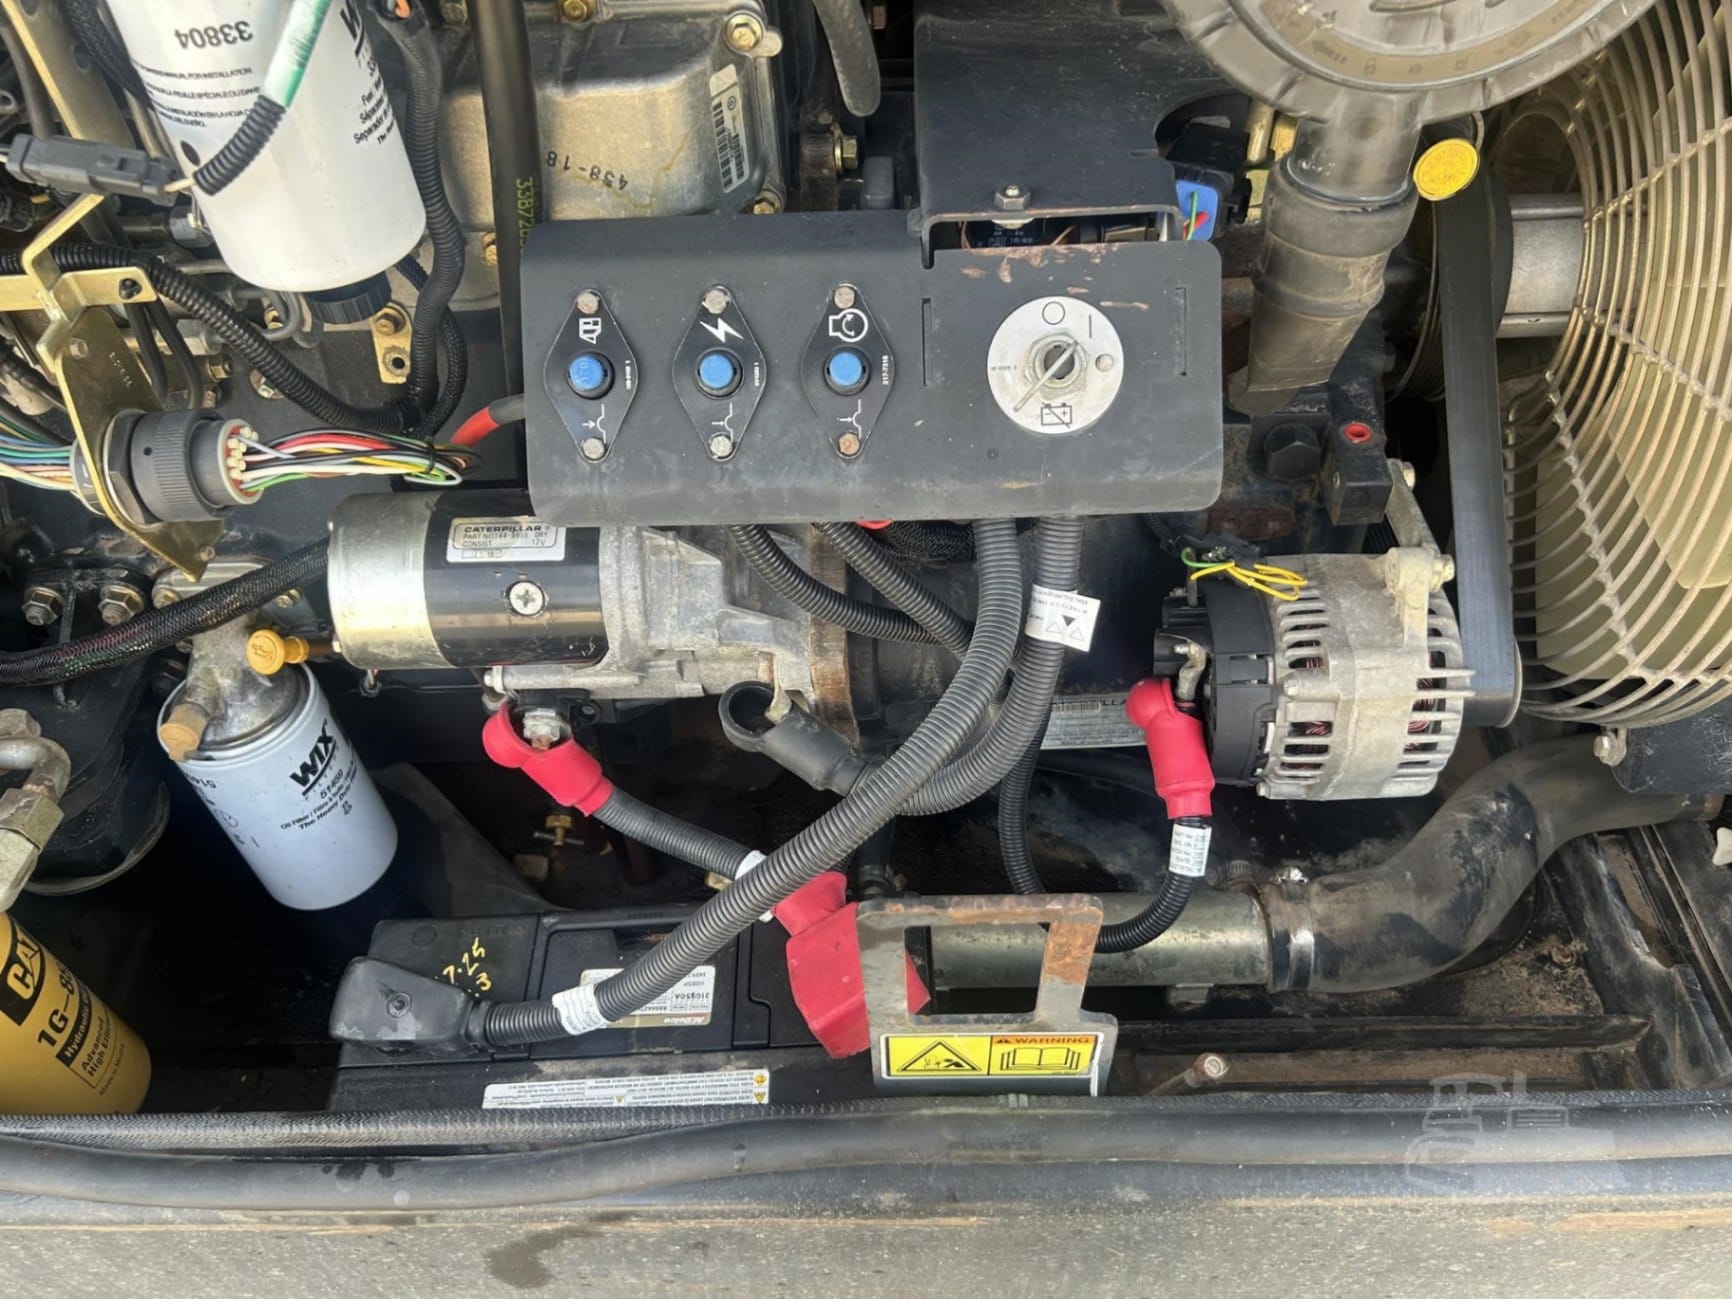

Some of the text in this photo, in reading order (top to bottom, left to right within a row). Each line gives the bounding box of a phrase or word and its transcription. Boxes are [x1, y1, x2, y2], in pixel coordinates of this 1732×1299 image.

[174, 20, 253, 50] 33804
[545, 149, 629, 190] 438-18
[464, 525, 542, 533] CATERPILLAR
[289, 718, 334, 787] WIX
[299, 819, 316, 831] The
[316, 800, 339, 821] Heavy
[6, 935, 40, 1000] CAT
[63, 1006, 90, 1058] Hydraulic
[664, 1016, 705, 1025] ACDelco
[81, 1016, 104, 1071] Advanced
[86, 1049, 104, 1077] High
